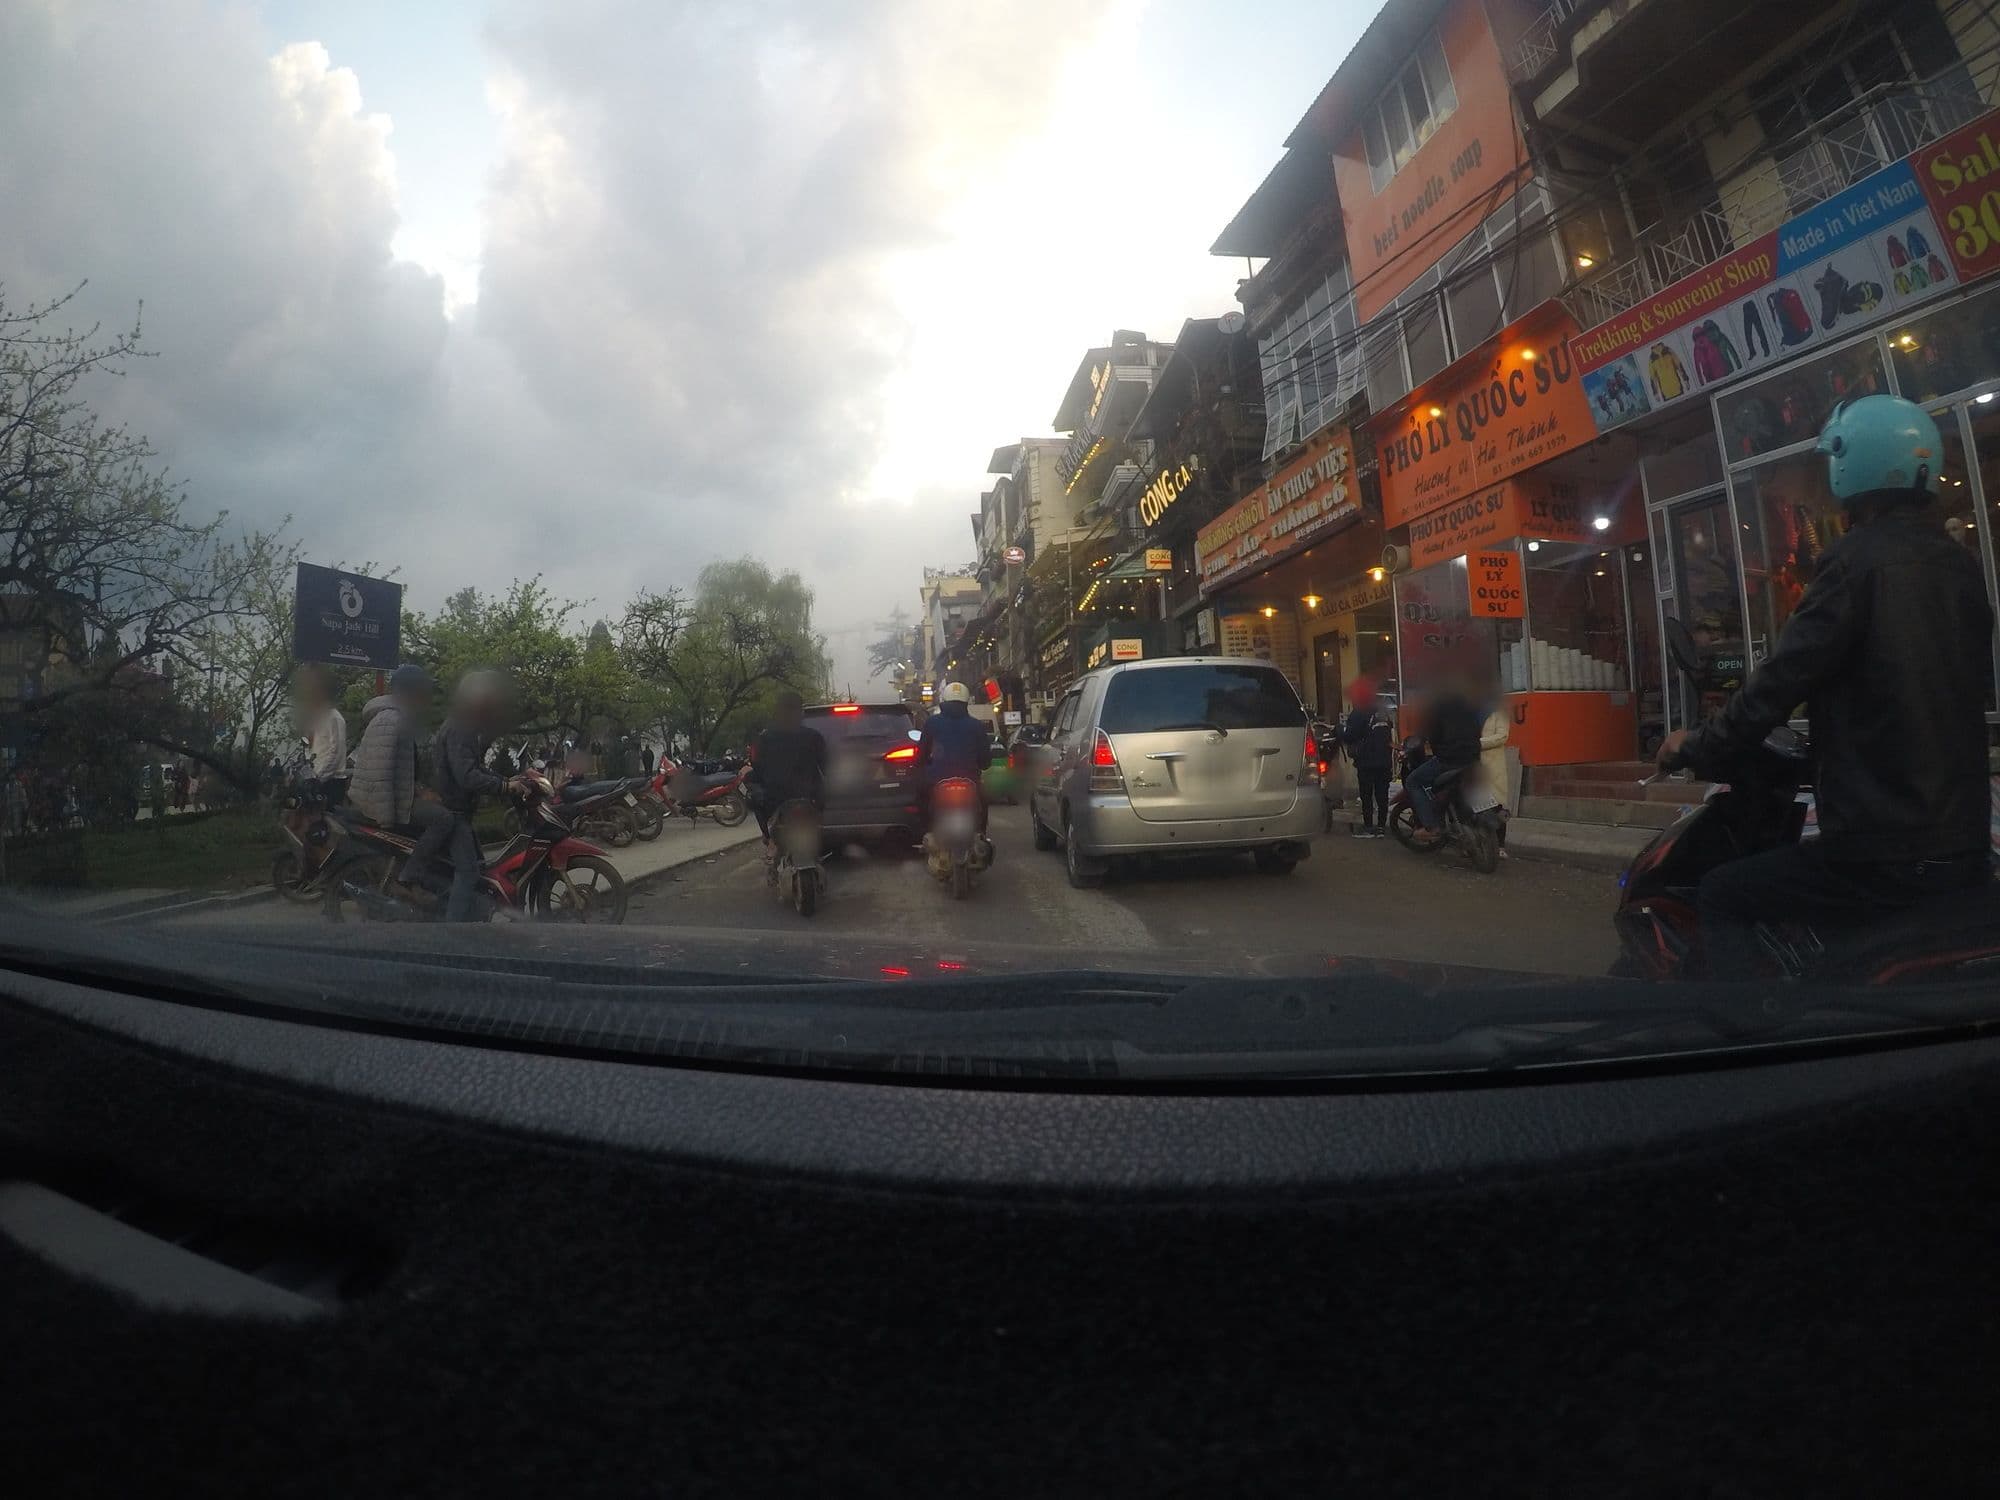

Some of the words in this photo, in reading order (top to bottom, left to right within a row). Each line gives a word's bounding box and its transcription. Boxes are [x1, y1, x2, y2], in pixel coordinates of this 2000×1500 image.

[1930, 132, 2000, 197] Sal
[1374, 215, 1398, 258] beef
[1402, 174, 1444, 231] noodle
[1451, 138, 1482, 184] soup
[1782, 227, 1825, 261] Made
[1827, 217, 1844, 238] in
[1843, 198, 1880, 228] Viet
[1879, 177, 1919, 217] Nam
[1575, 321, 1639, 364] Trekking
[1640, 307, 1655, 332] &
[1653, 275, 1723, 324] Souvenir
[1723, 252, 1772, 291] Shop
[1384, 415, 1423, 478] PHỞ
[1456, 359, 1527, 442] QUỐC
[1532, 335, 1571, 395] SƯ
[1284, 466, 1315, 503] THỰC
[1449, 494, 1483, 529] QUỐC
[1480, 553, 1508, 567] PHỞ
[1486, 568, 1504, 581] LÝ
[1477, 584, 1520, 599] QUỐC
[1487, 601, 1508, 612] SƯ
[1717, 660, 1743, 670] OPEN
